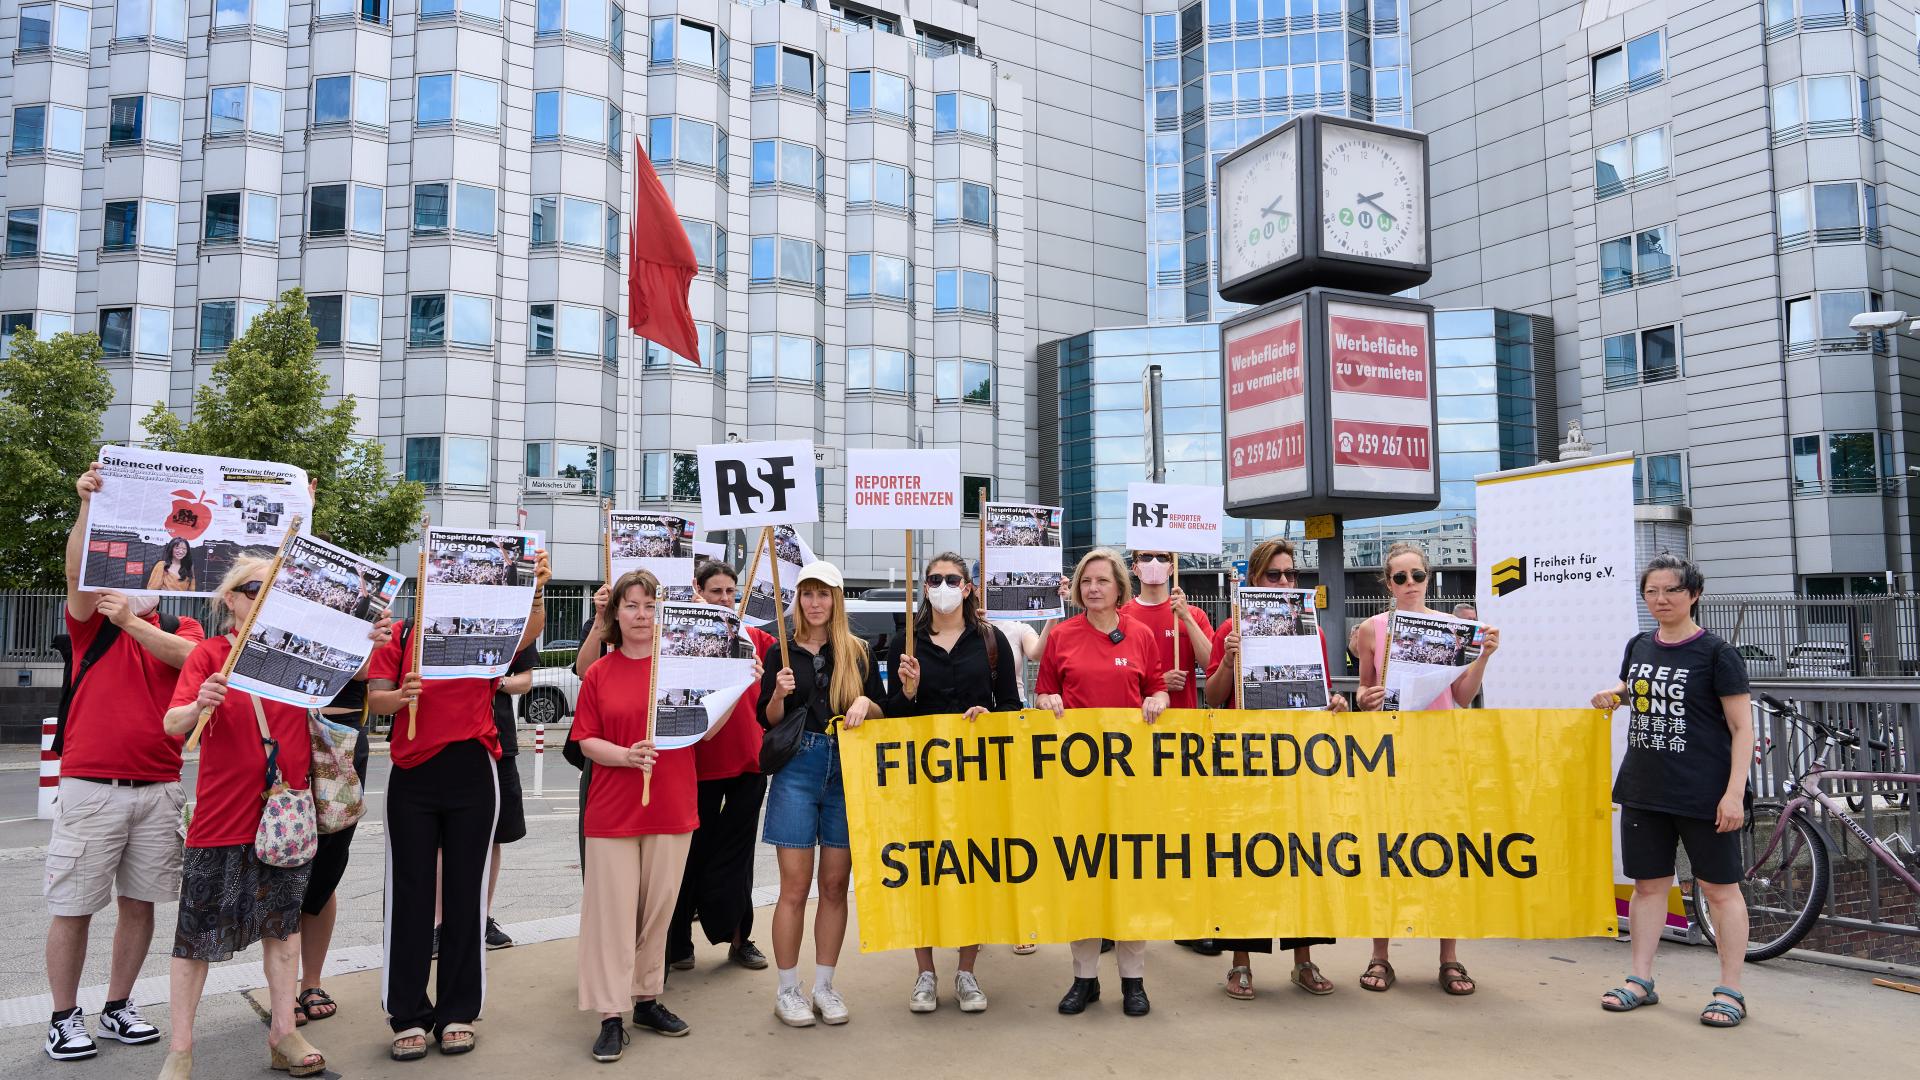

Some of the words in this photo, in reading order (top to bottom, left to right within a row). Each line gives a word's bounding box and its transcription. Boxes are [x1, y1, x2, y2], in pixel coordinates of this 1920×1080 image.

[1335, 333, 1418, 357] Werbefläche
[1232, 340, 1296, 372] Werbefläche
[1232, 382, 1244, 395] zu
[1247, 365, 1300, 391] vermieten
[1336, 362, 1352, 375] zu
[1356, 363, 1423, 382] vermieten
[1247, 442, 1264, 464] 259
[1266, 439, 1282, 460] 267
[1285, 435, 1302, 456] 111
[1358, 433, 1378, 454] 259
[1382, 435, 1402, 455] 267
[1406, 437, 1425, 457] 111
[102, 456, 162, 470] Silenced
[165, 464, 204, 475] voices
[219, 465, 262, 475] Repressing
[276, 471, 297, 479] press
[531, 481, 563, 489] Märkisches
[563, 481, 577, 489] Ufer
[715, 456, 796, 515] RSF
[855, 475, 921, 489] REPORTER
[855, 491, 890, 505] OHNE
[895, 491, 954, 506] GRENZEN
[988, 512, 1012, 521] lives
[1132, 502, 1168, 528] RSF
[1169, 514, 1201, 522] REPORTER
[612, 521, 640, 530] lives
[1168, 521, 1186, 529] OHNE
[1187, 522, 1217, 530] GRENZEN
[431, 540, 466, 551] lives
[467, 543, 487, 553] on
[290, 545, 328, 568] lives
[327, 563, 347, 576] on
[296, 538, 310, 549] The
[310, 544, 331, 557] spirit
[362, 565, 382, 578] Daily
[1534, 555, 1575, 567] Freiheit
[1580, 553, 1597, 564] für
[1534, 569, 1592, 583] Hongkong
[1596, 566, 1615, 578] e.V.
[1241, 599, 1266, 608] lives
[664, 614, 695, 625] lives
[697, 618, 713, 627] on
[1409, 618, 1426, 626] spirit
[1453, 624, 1470, 632] Daily
[1396, 623, 1424, 635] lives
[1426, 628, 1442, 637] on
[1628, 663, 1689, 683] FREE
[875, 735, 1014, 787] FIGHT
[1032, 732, 1135, 779] FOR
[1152, 732, 1396, 777] FREEDOM
[1839, 811, 1873, 844] Raleigh
[880, 836, 1038, 888] STAND
[1053, 832, 1190, 881] WITH
[1206, 832, 1361, 877] HONG
[1377, 832, 1538, 879] KONG
